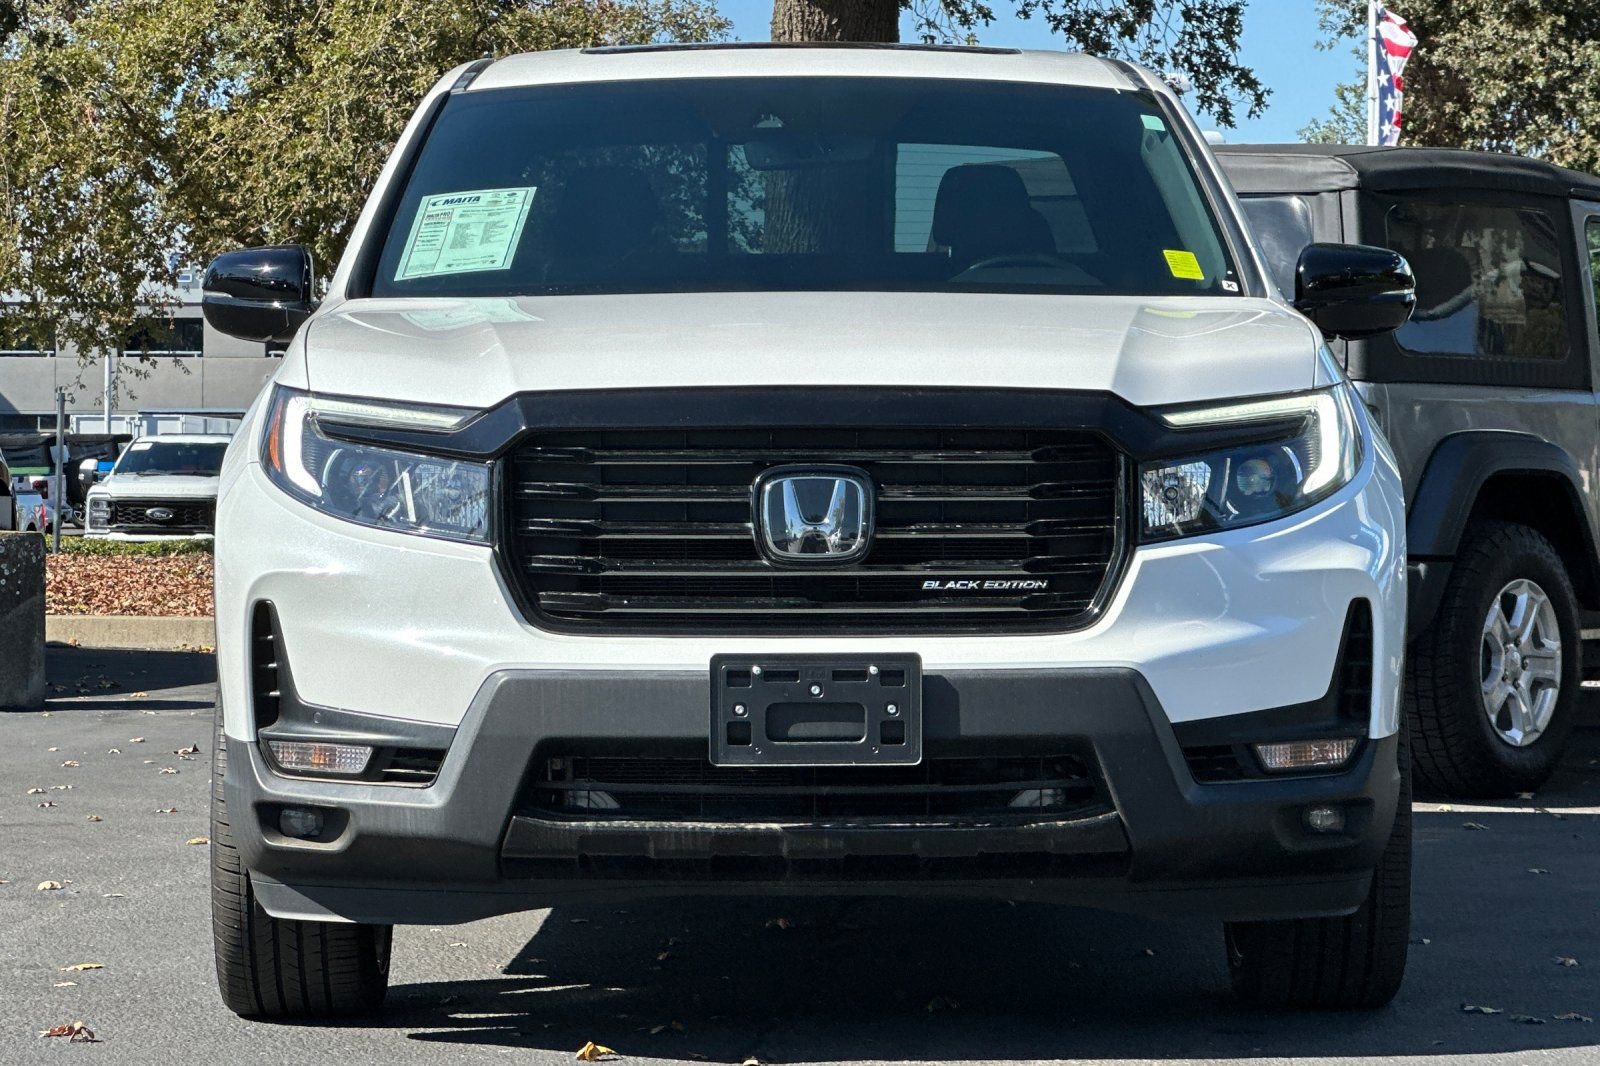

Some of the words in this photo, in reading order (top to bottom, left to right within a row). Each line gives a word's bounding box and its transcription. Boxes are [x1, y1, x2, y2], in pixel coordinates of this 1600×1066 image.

[442, 196, 481, 205] MAITA
[922, 580, 981, 590] BLACK
[983, 580, 1048, 590] EDITION
